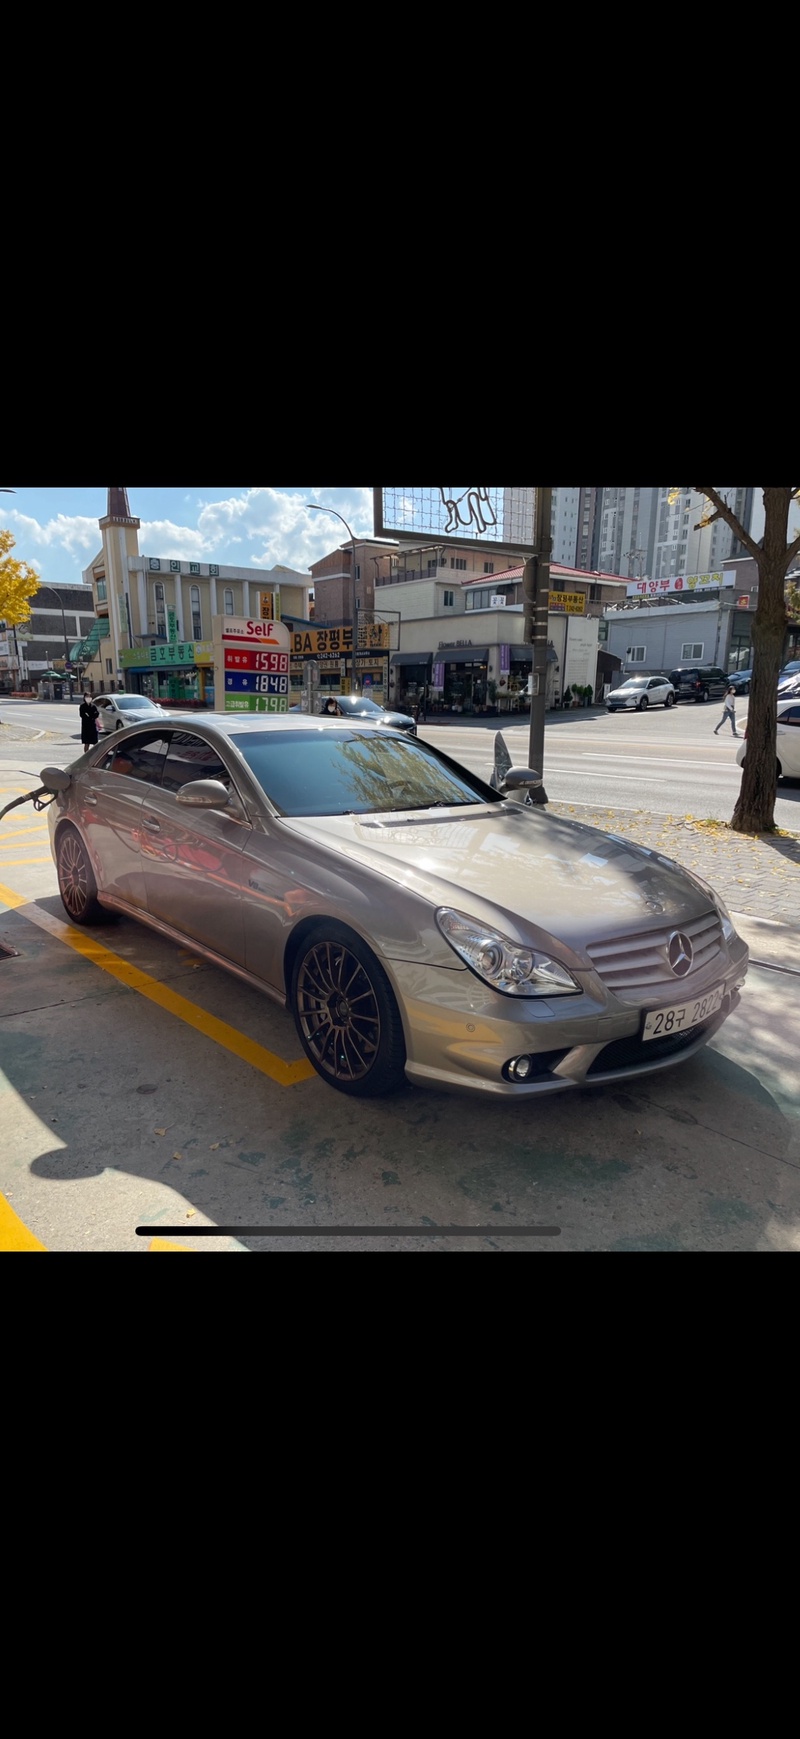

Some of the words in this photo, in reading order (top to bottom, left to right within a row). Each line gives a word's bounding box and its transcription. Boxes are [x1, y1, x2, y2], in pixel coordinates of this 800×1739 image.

[637, 579, 670, 594] 대양부
[687, 573, 723, 590] 양꼬치
[247, 621, 274, 637] Self
[150, 643, 195, 662] 금호부동산
[255, 653, 288, 671] 1598
[255, 675, 287, 693] 1848
[255, 697, 287, 712] 1798
[653, 1009, 686, 1035] 28구
[691, 990, 720, 1023] 2822
